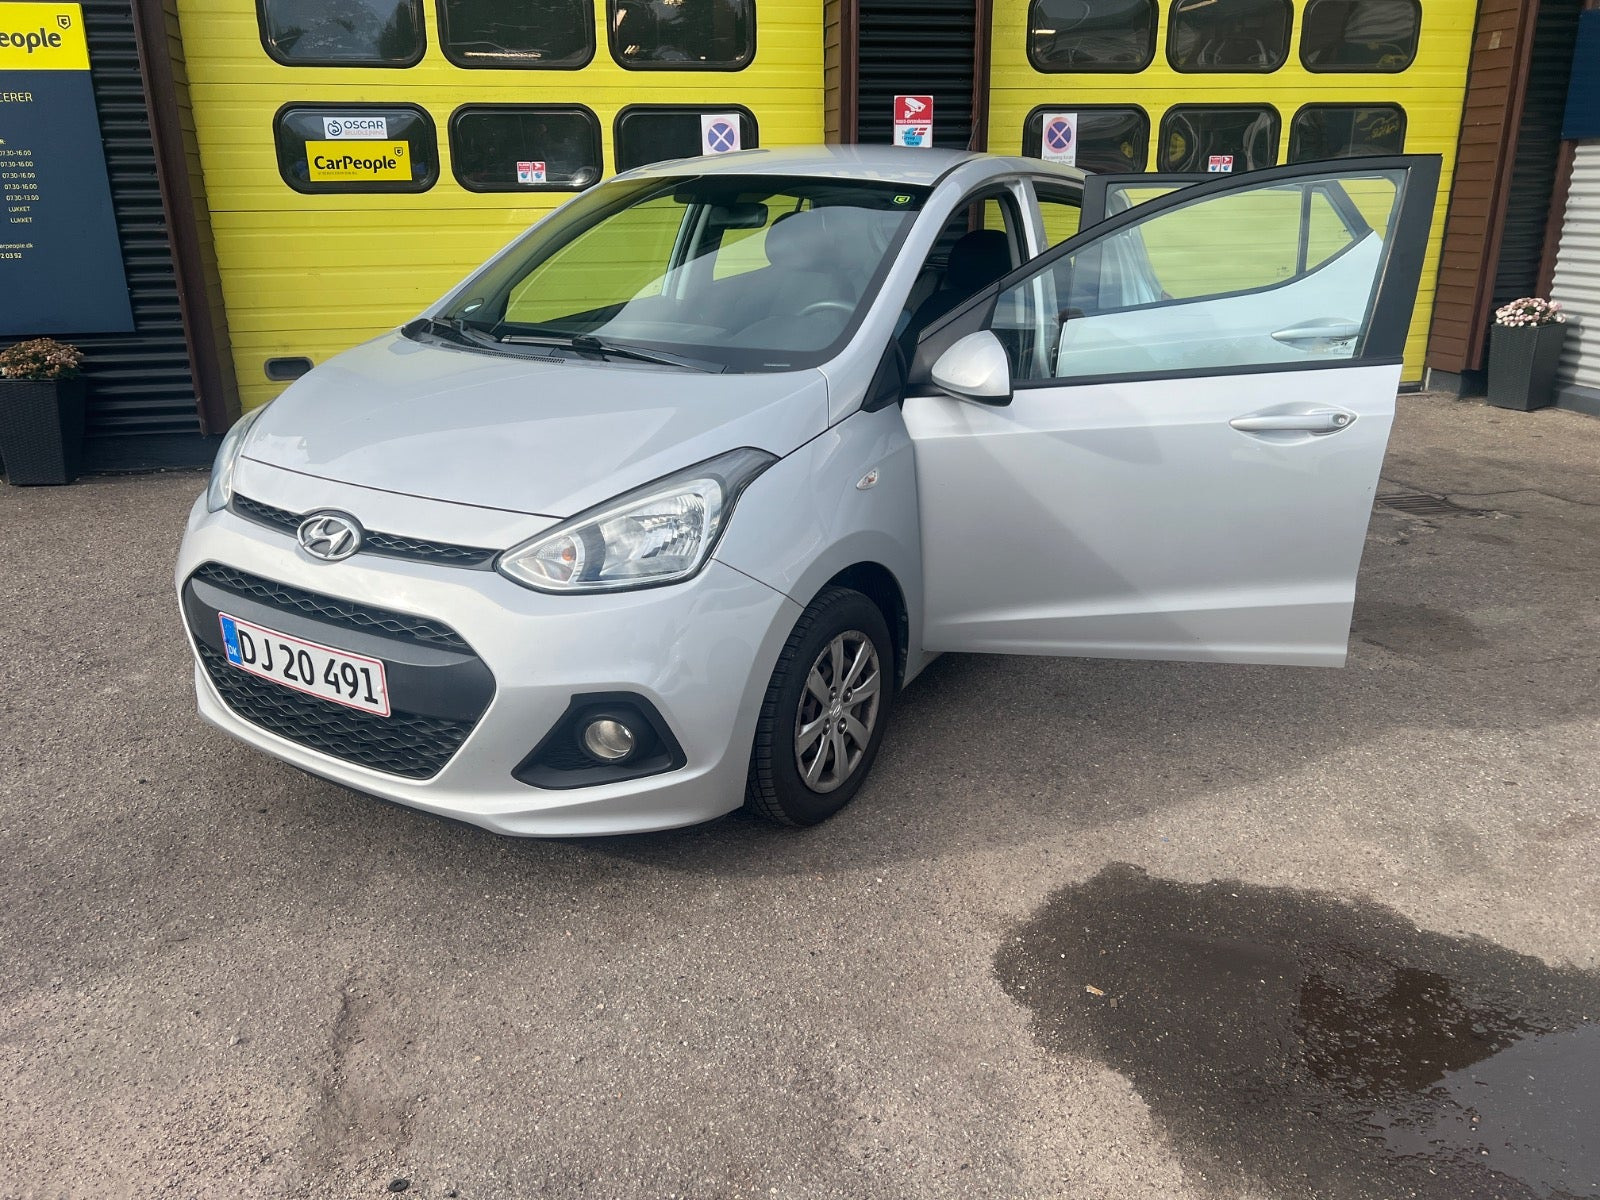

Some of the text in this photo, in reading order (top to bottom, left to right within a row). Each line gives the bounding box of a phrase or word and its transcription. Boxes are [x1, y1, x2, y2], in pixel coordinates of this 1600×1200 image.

[0, 28, 61, 53] eople
[344, 120, 384, 129] OSCAR
[314, 155, 396, 173] CarPeople
[228, 644, 239, 657] DK
[238, 629, 378, 704] DJ 20 491
